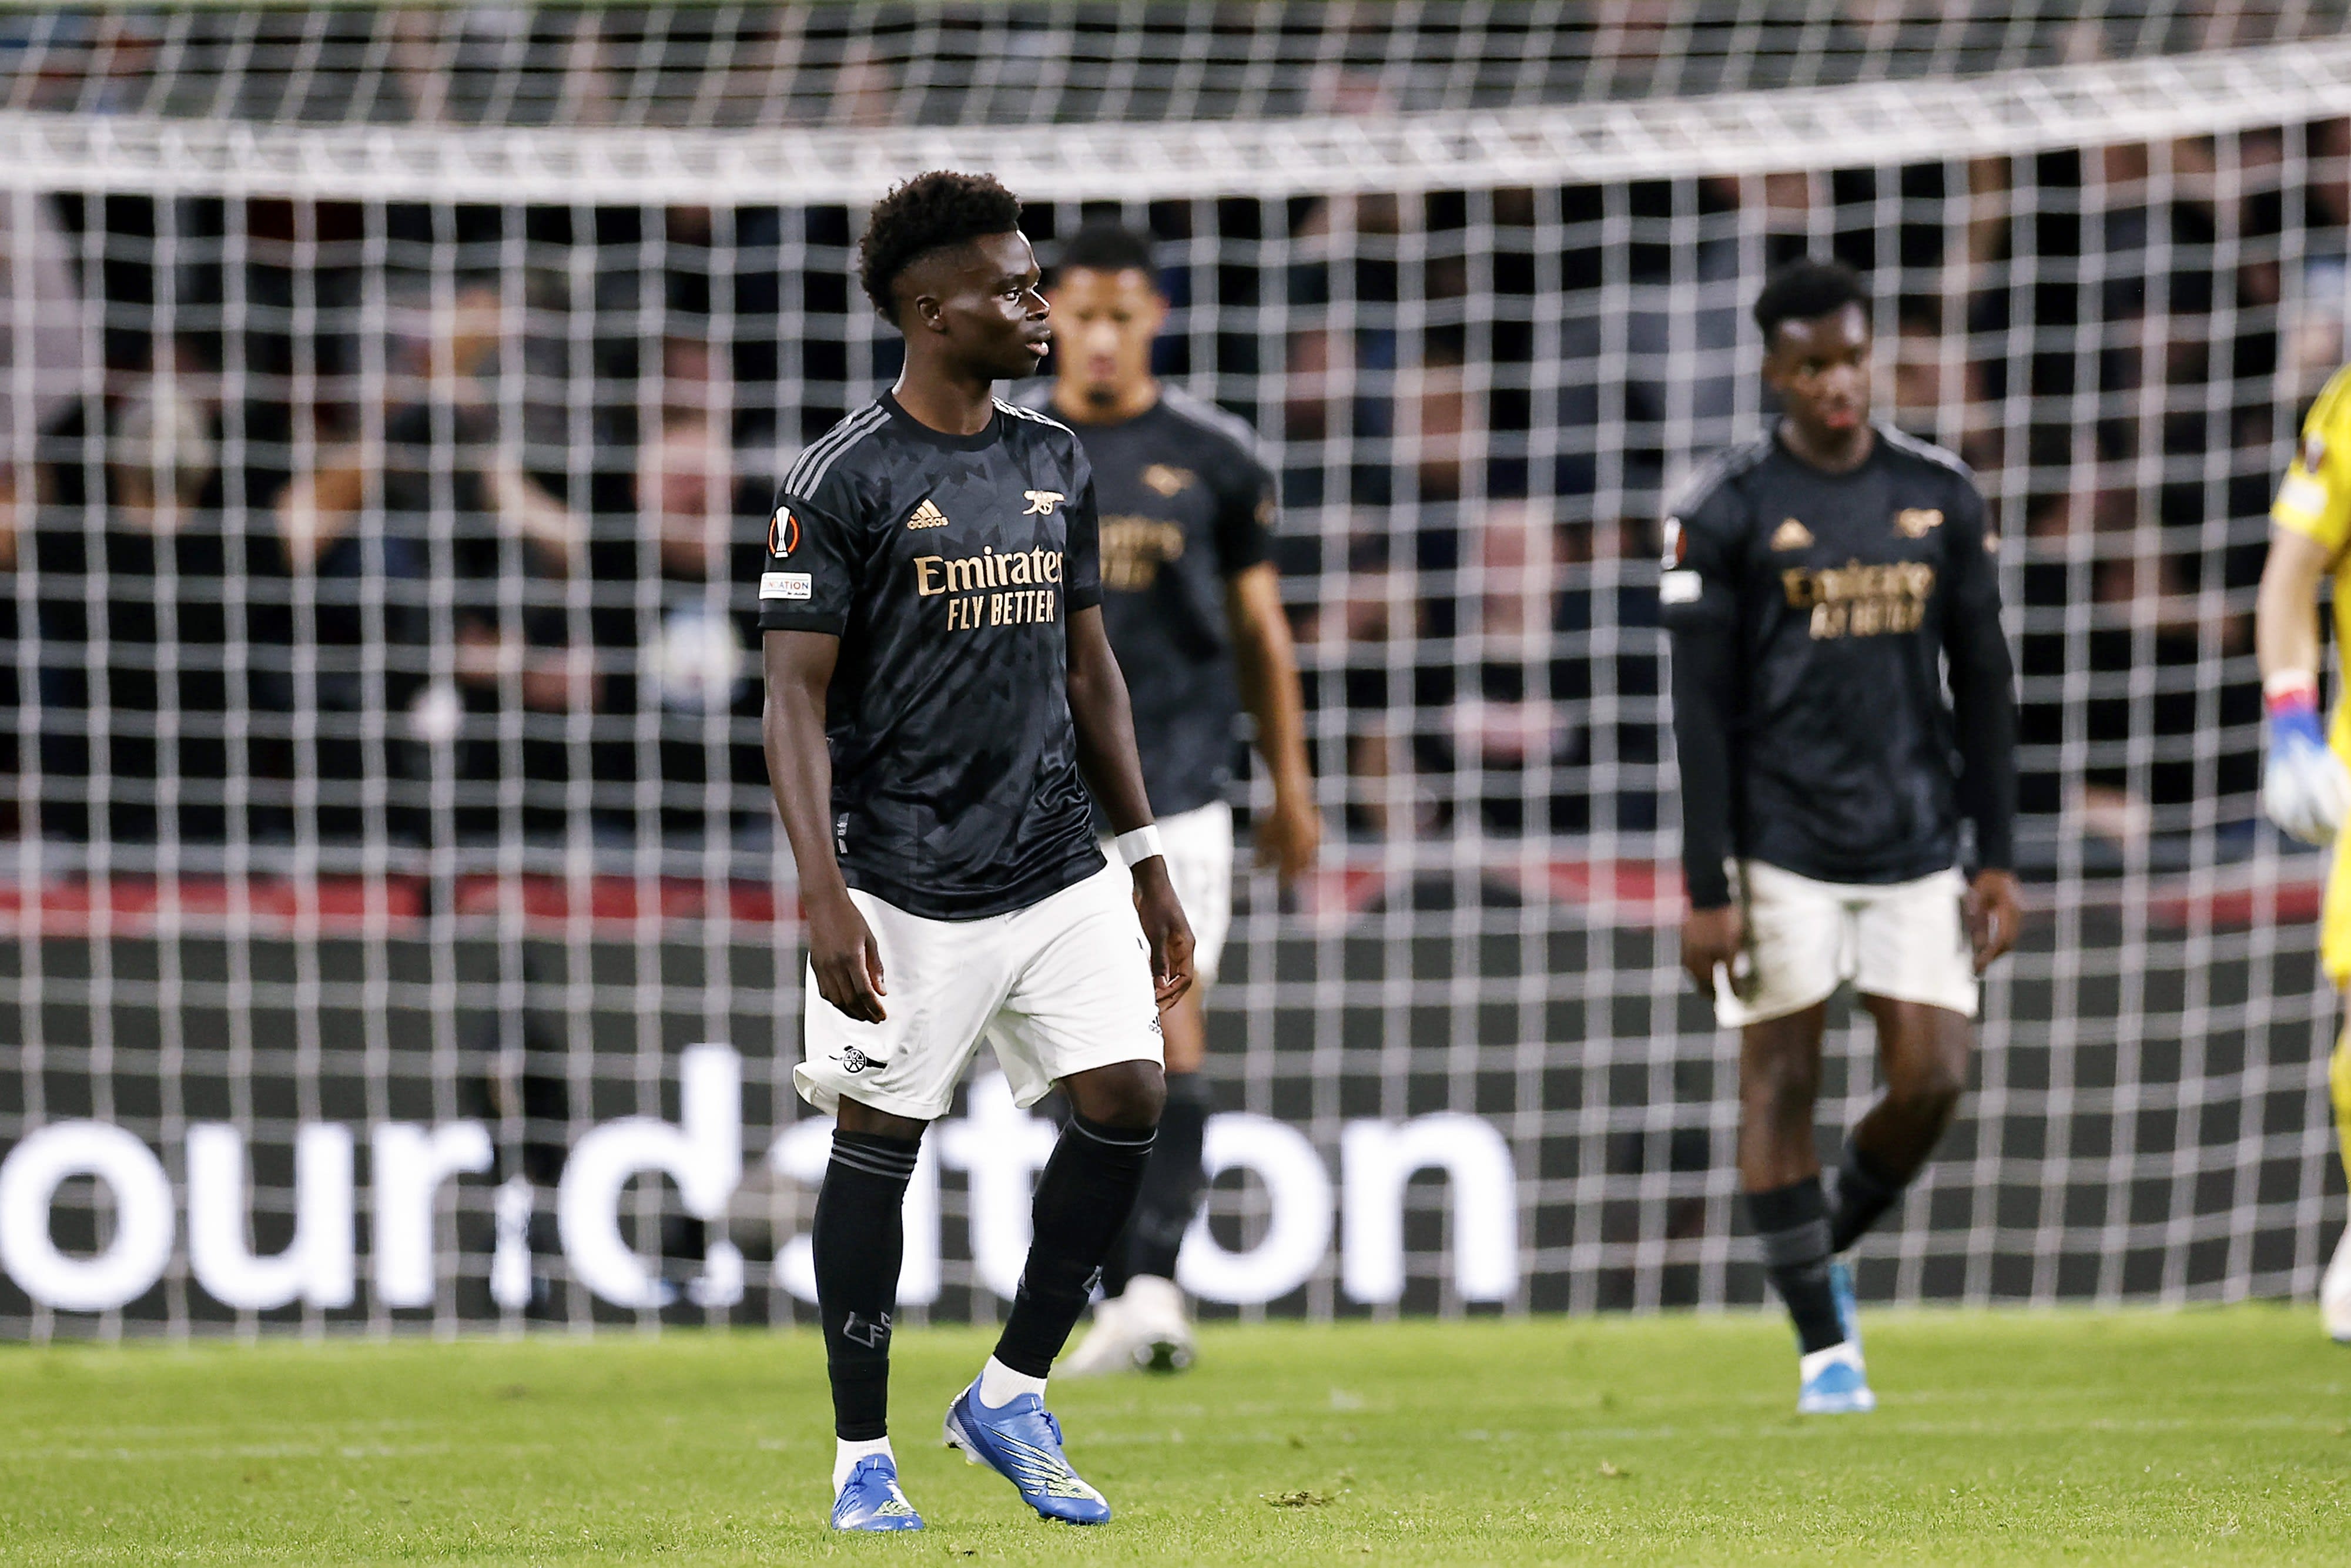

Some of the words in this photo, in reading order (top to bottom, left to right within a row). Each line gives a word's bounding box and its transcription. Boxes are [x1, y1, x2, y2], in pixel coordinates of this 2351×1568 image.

[907, 517, 949, 530] adidas
[947, 597, 984, 631] FLY
[991, 590, 1054, 626] BETTER
